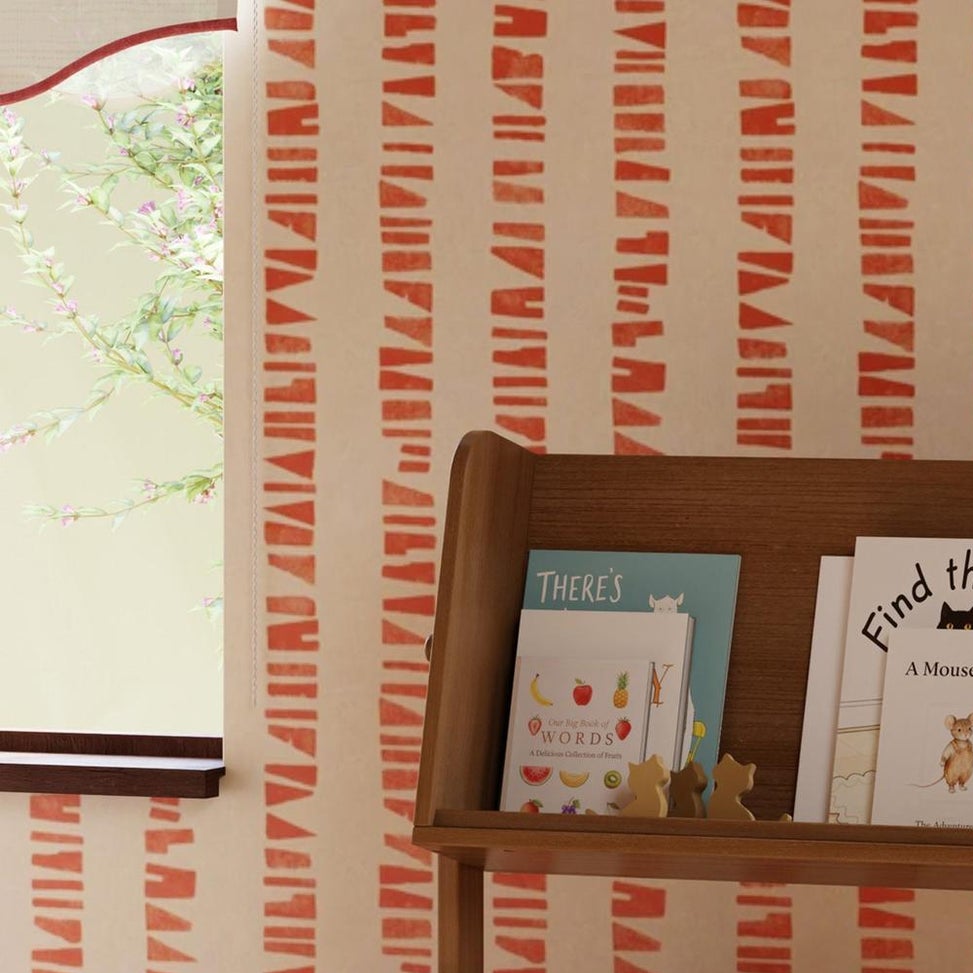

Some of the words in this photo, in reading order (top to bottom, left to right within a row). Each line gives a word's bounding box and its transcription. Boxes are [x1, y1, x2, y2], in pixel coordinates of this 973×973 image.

[536, 567, 623, 603] THERE'S
[862, 563, 932, 652] Find
[905, 662, 918, 676] A
[542, 730, 614, 746] WORDS
